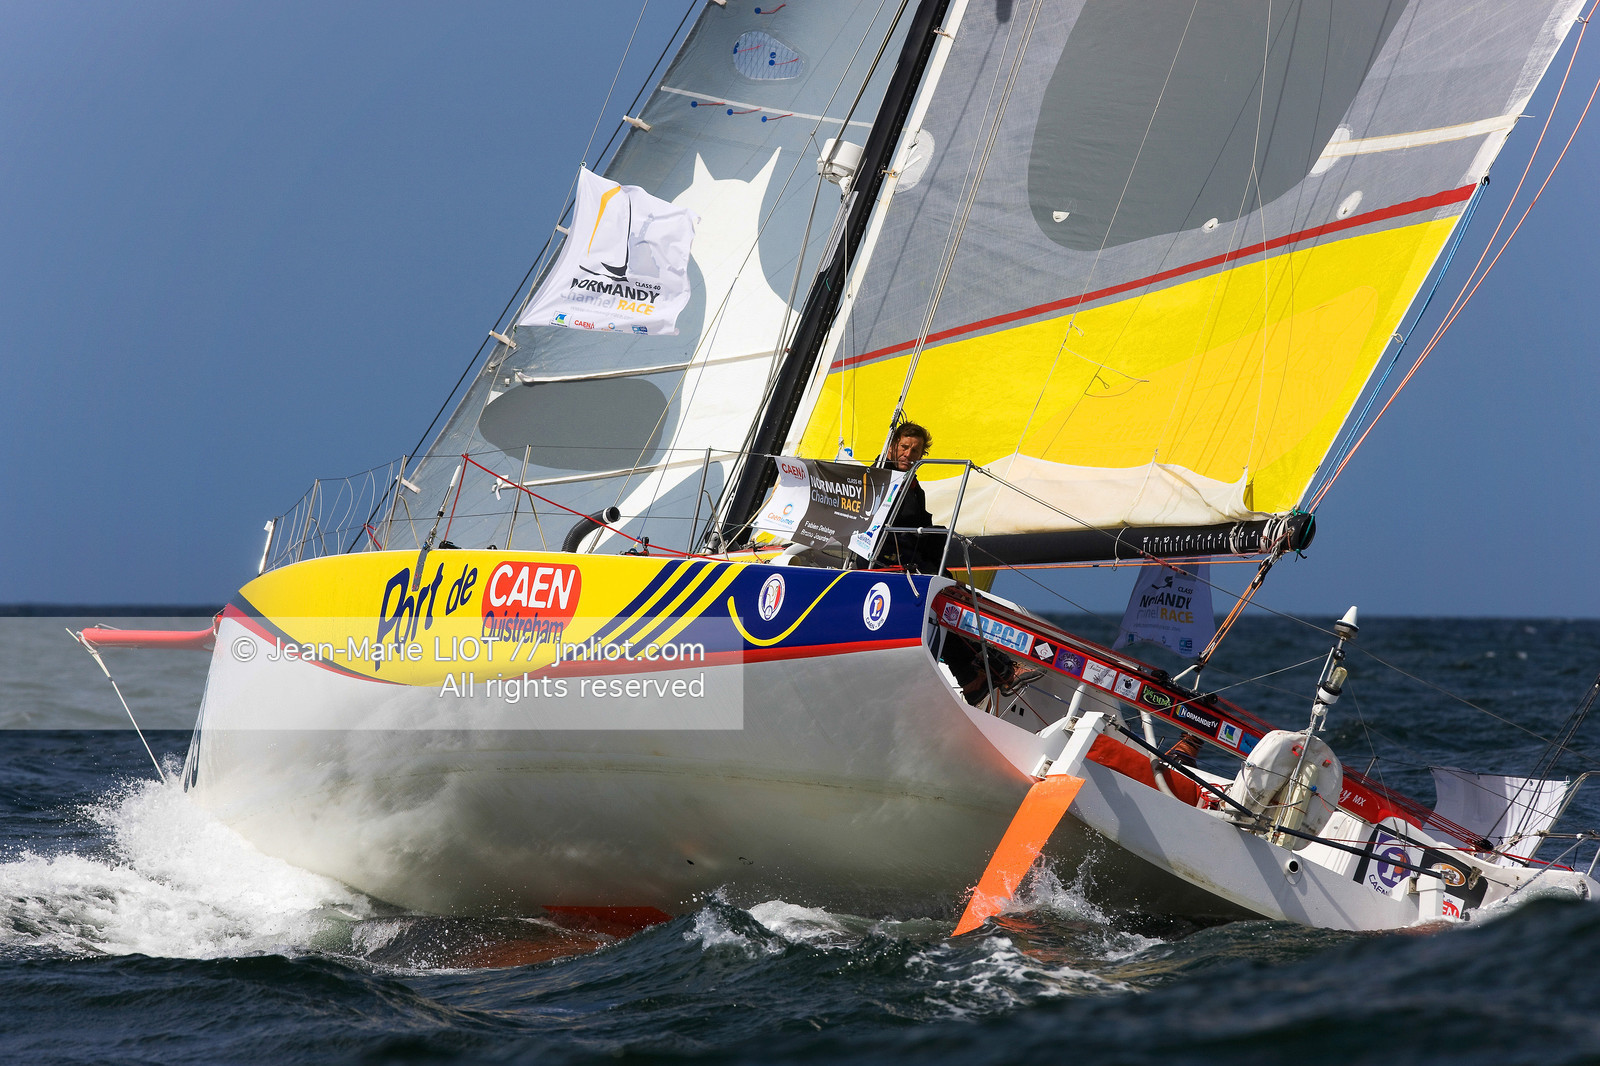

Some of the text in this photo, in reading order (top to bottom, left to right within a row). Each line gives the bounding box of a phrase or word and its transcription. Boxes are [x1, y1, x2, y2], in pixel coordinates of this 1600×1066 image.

[635, 281, 652, 289] CLASS
[616, 299, 655, 316] RACE
[781, 463, 802, 477] CAEN
[810, 475, 862, 499] NORMANDY
[811, 489, 861, 513] Channel RACE
[489, 564, 576, 610] CAEN
[375, 562, 478, 672] Port de
[481, 610, 564, 645] Ouistreham
[1160, 608, 1194, 624] RACE
